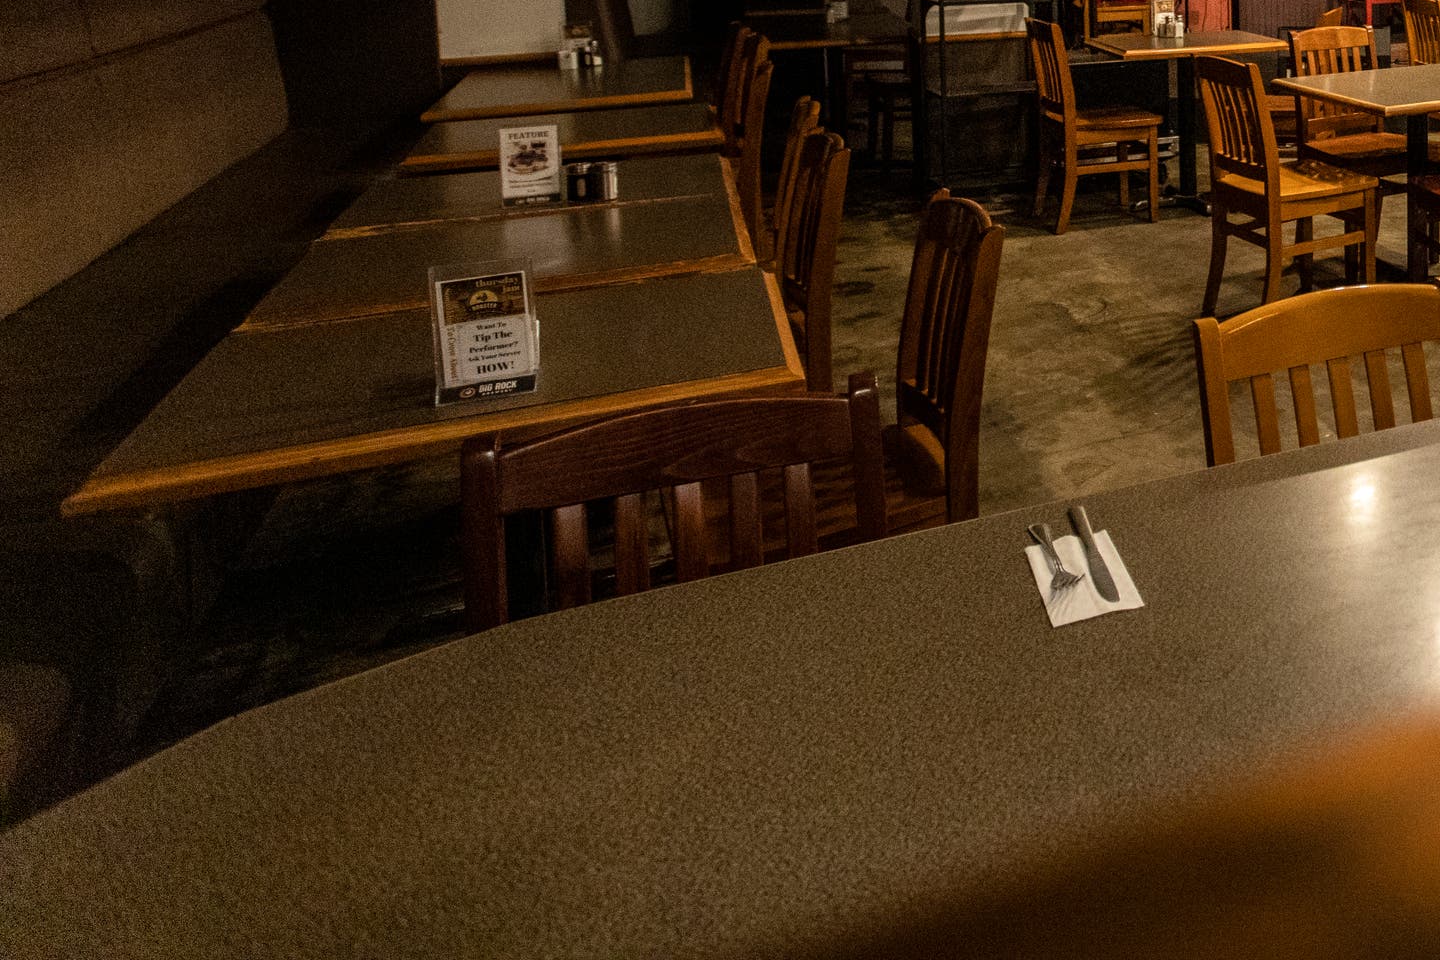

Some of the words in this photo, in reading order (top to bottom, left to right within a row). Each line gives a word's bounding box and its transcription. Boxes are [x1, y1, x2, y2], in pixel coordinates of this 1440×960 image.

[508, 130, 549, 140] FEATURE
[473, 333, 491, 343] Tip
[493, 331, 512, 340] The
[469, 341, 518, 354] Performer?
[477, 361, 514, 374] HOW!
[478, 383, 493, 393] BIG
[494, 380, 518, 391] ROCK
